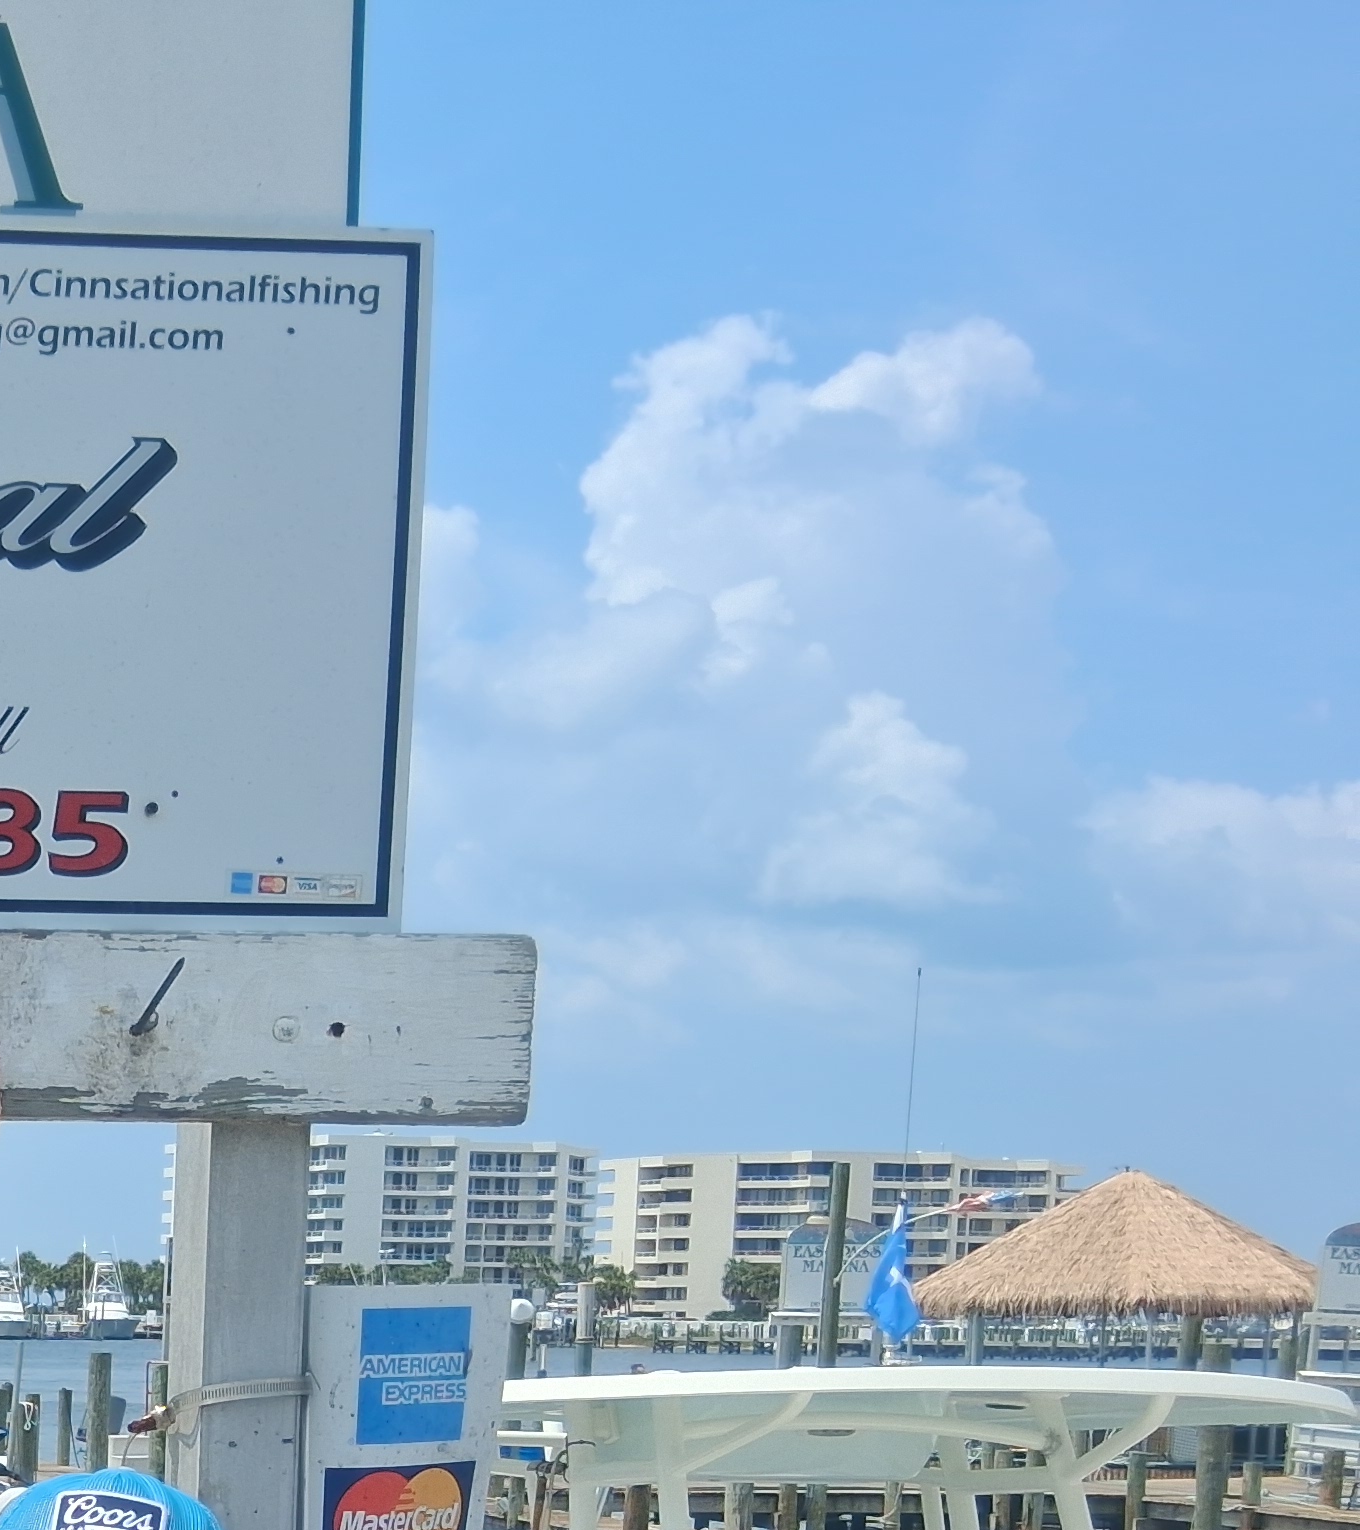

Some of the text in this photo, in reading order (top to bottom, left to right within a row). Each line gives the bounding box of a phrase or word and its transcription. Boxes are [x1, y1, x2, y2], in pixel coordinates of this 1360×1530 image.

[298, 882, 317, 891] VISA
[361, 1354, 462, 1376] AMERICAN
[384, 1382, 466, 1401] EXPRESS
